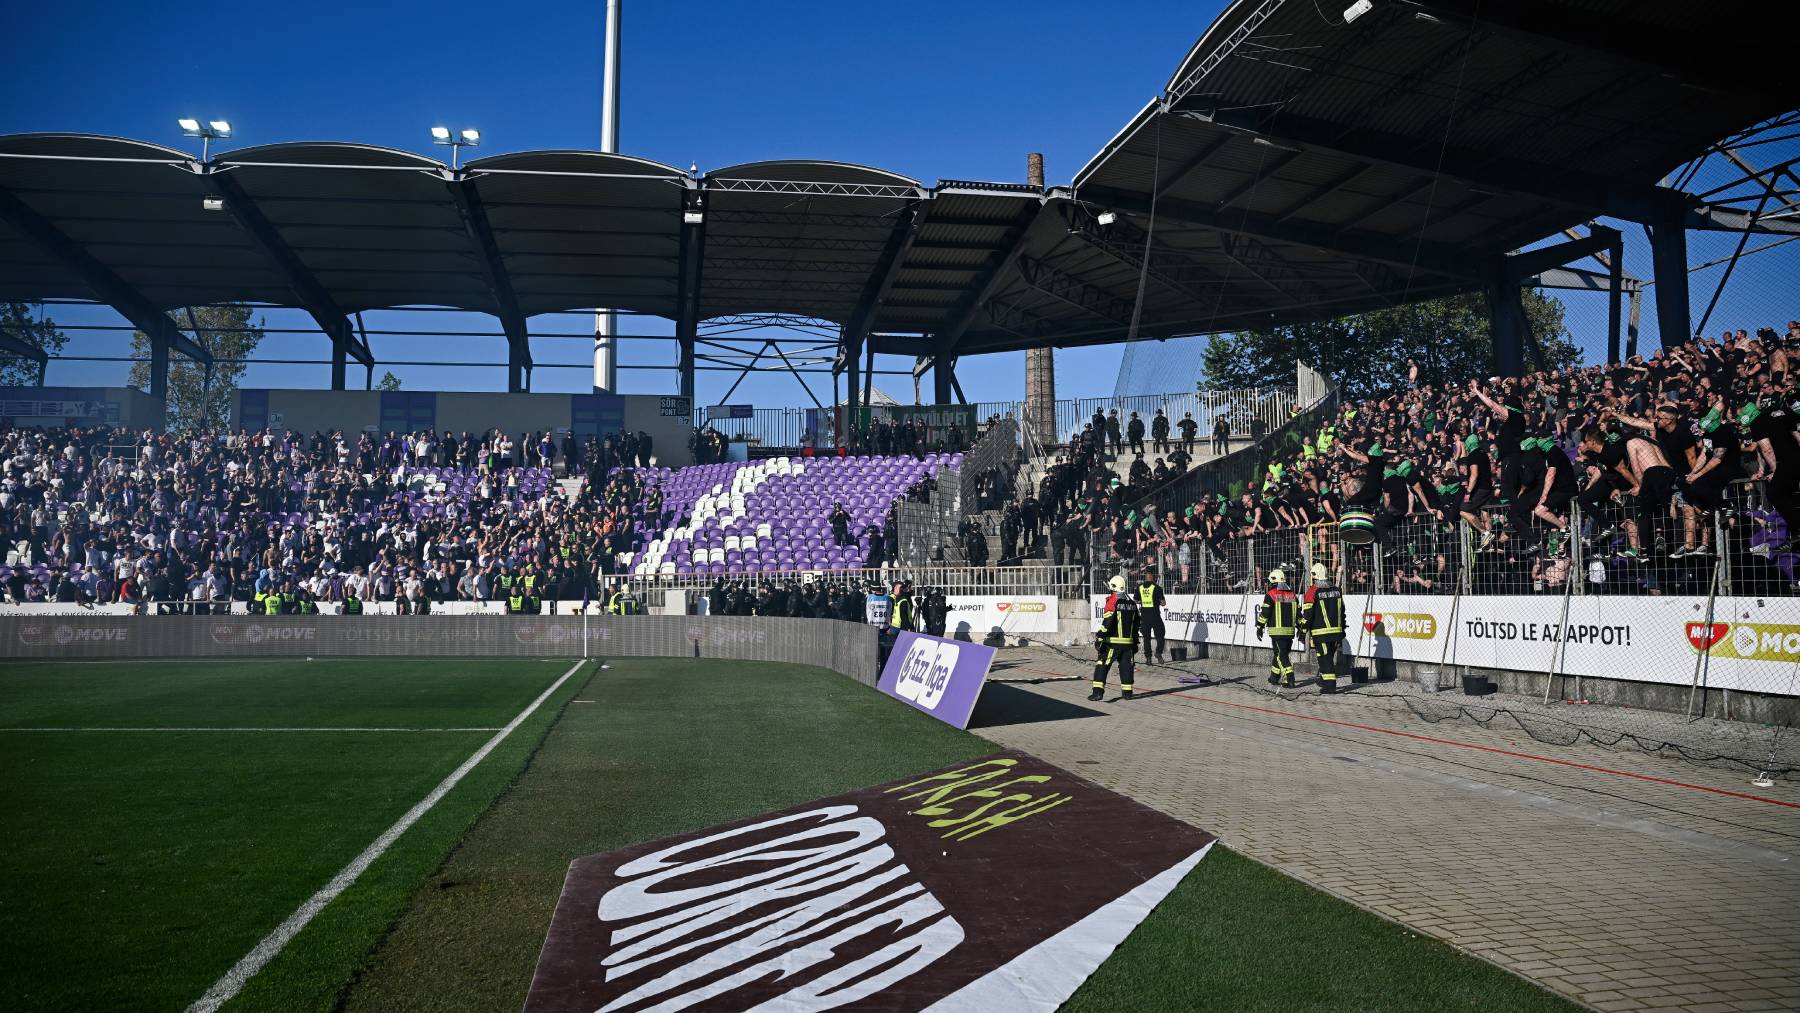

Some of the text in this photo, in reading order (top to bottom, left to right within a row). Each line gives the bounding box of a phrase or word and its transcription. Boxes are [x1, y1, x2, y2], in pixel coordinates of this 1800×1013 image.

[267, 627, 316, 640] MOVE
[1397, 618, 1432, 634] MOVE
[1466, 617, 1631, 646] TÖLTSD LE AZ APPOT!
[76, 628, 128, 641] MOVE
[908, 649, 949, 698] fizz liga
